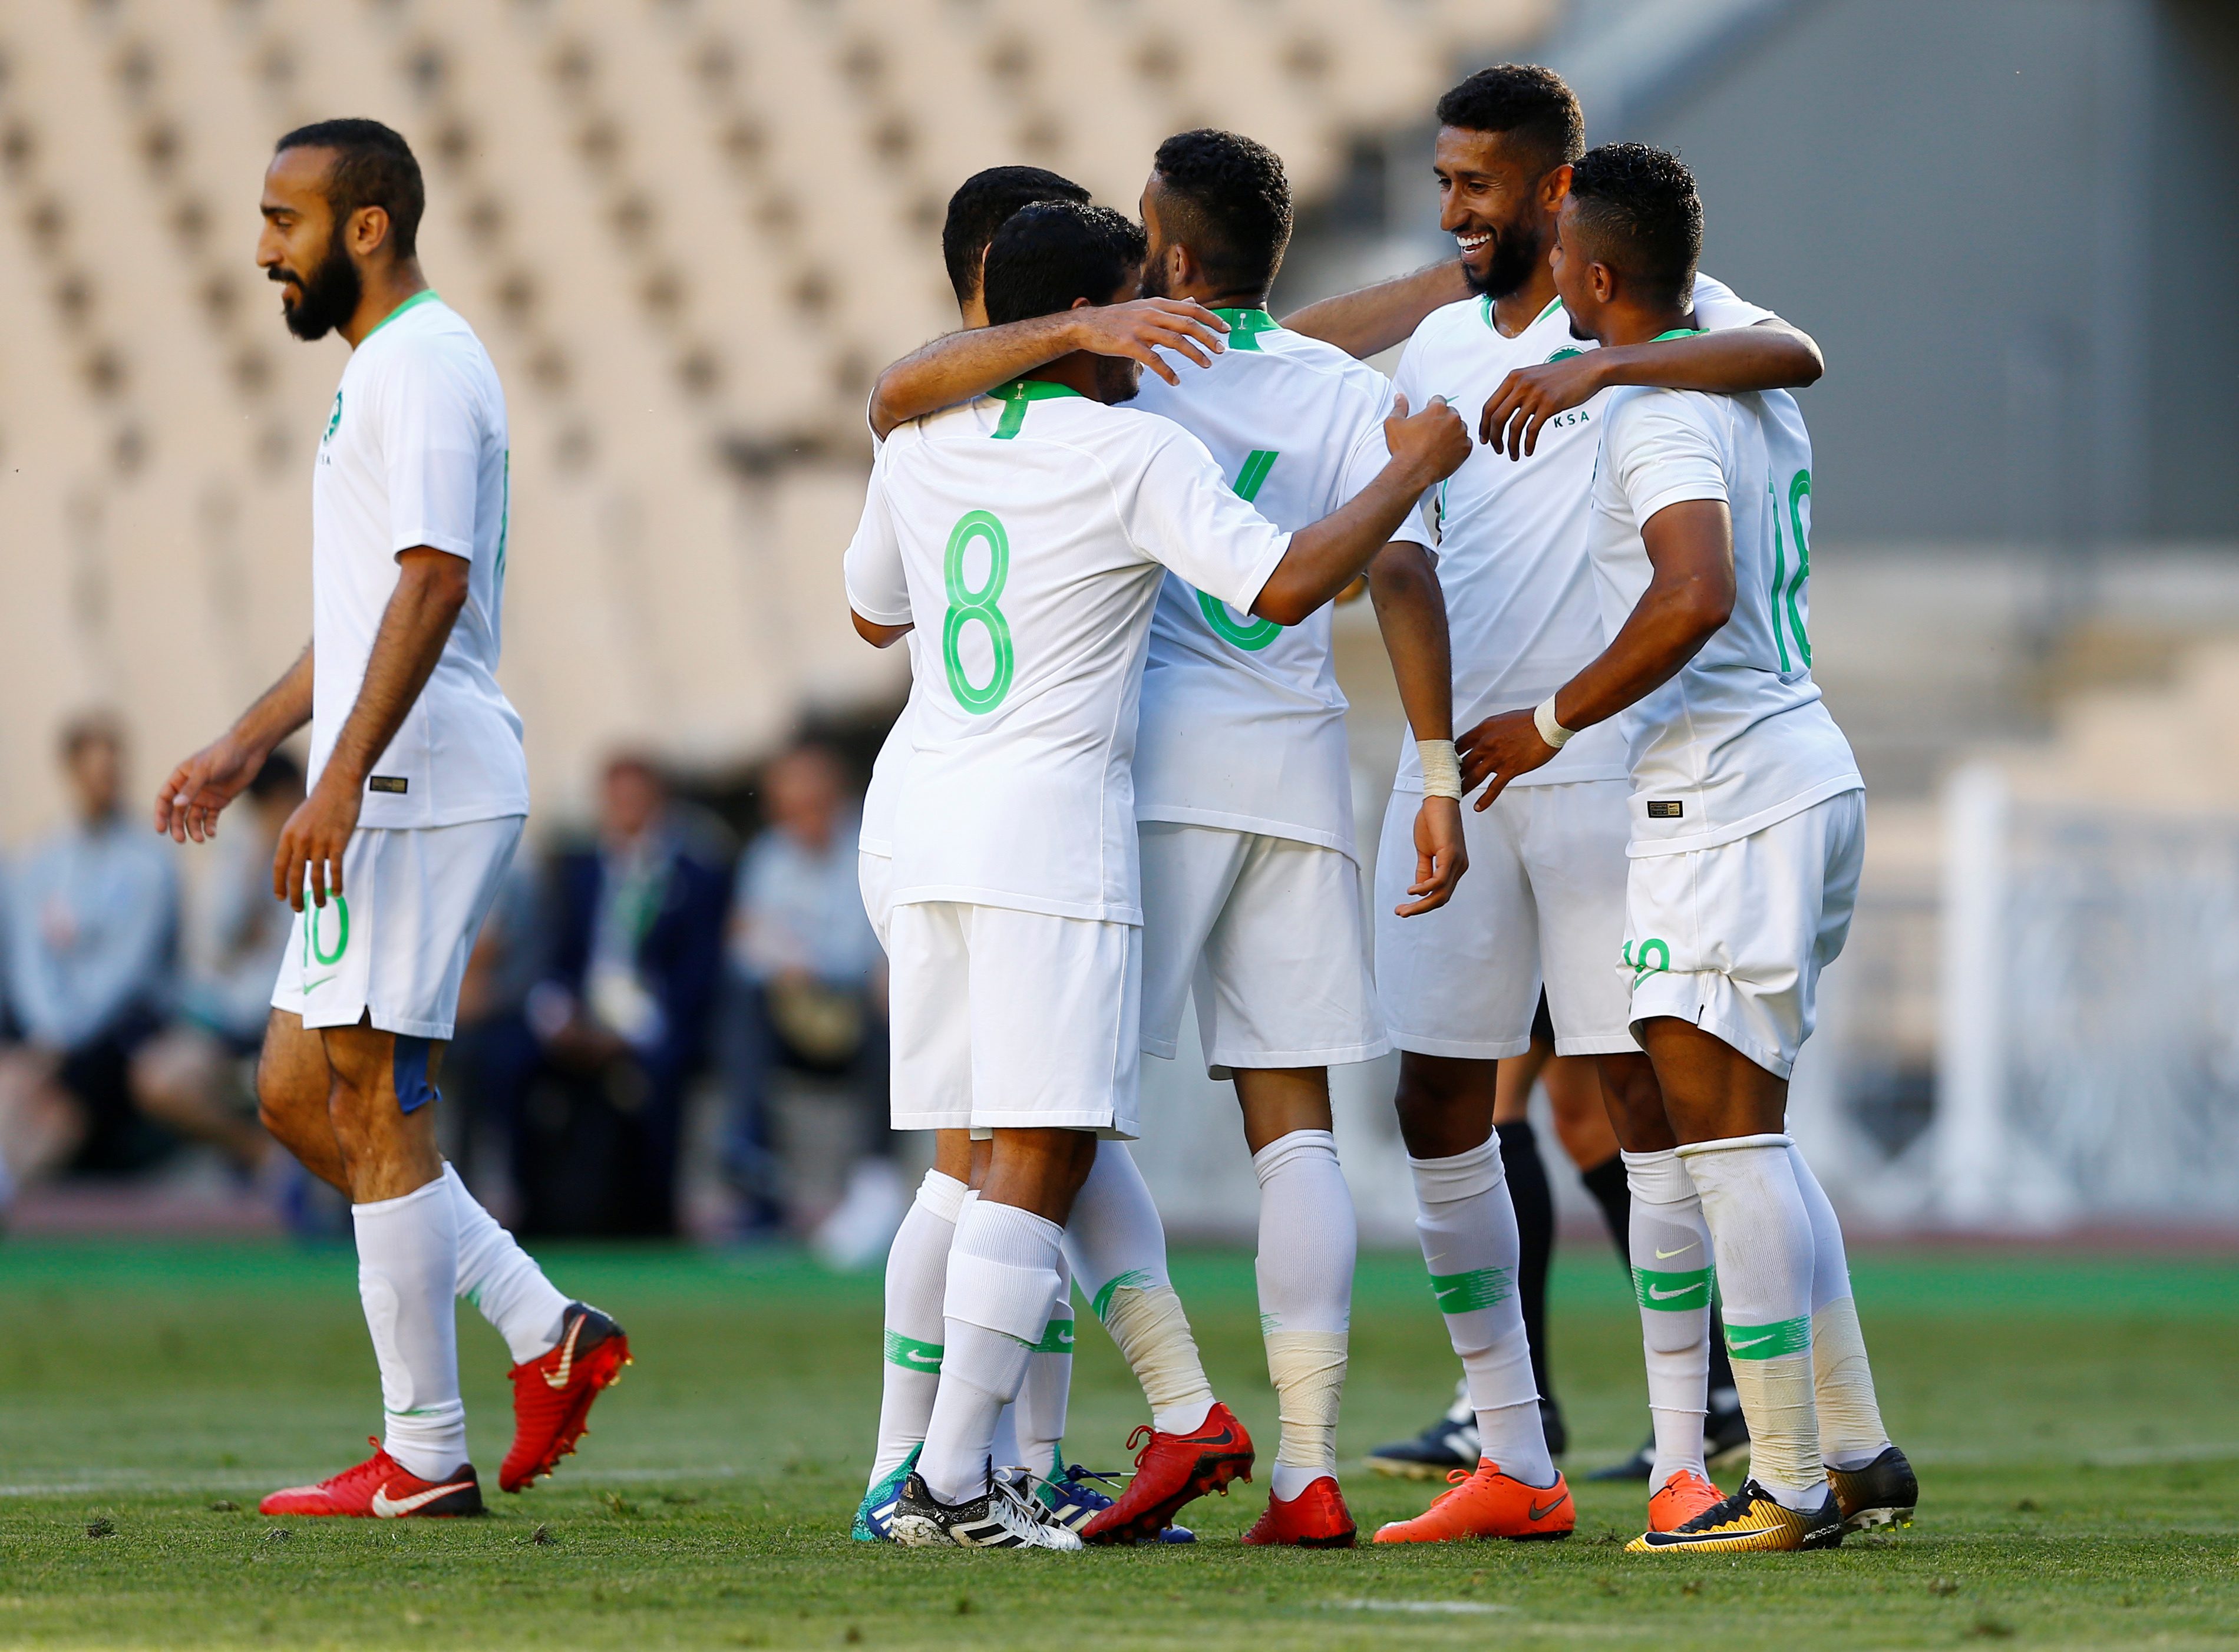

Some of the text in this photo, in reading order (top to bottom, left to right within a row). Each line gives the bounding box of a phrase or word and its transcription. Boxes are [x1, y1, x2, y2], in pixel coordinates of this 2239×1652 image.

[1554, 411, 1590, 428] KSA
[942, 510, 1014, 715] 8
[303, 888, 349, 968] 10
